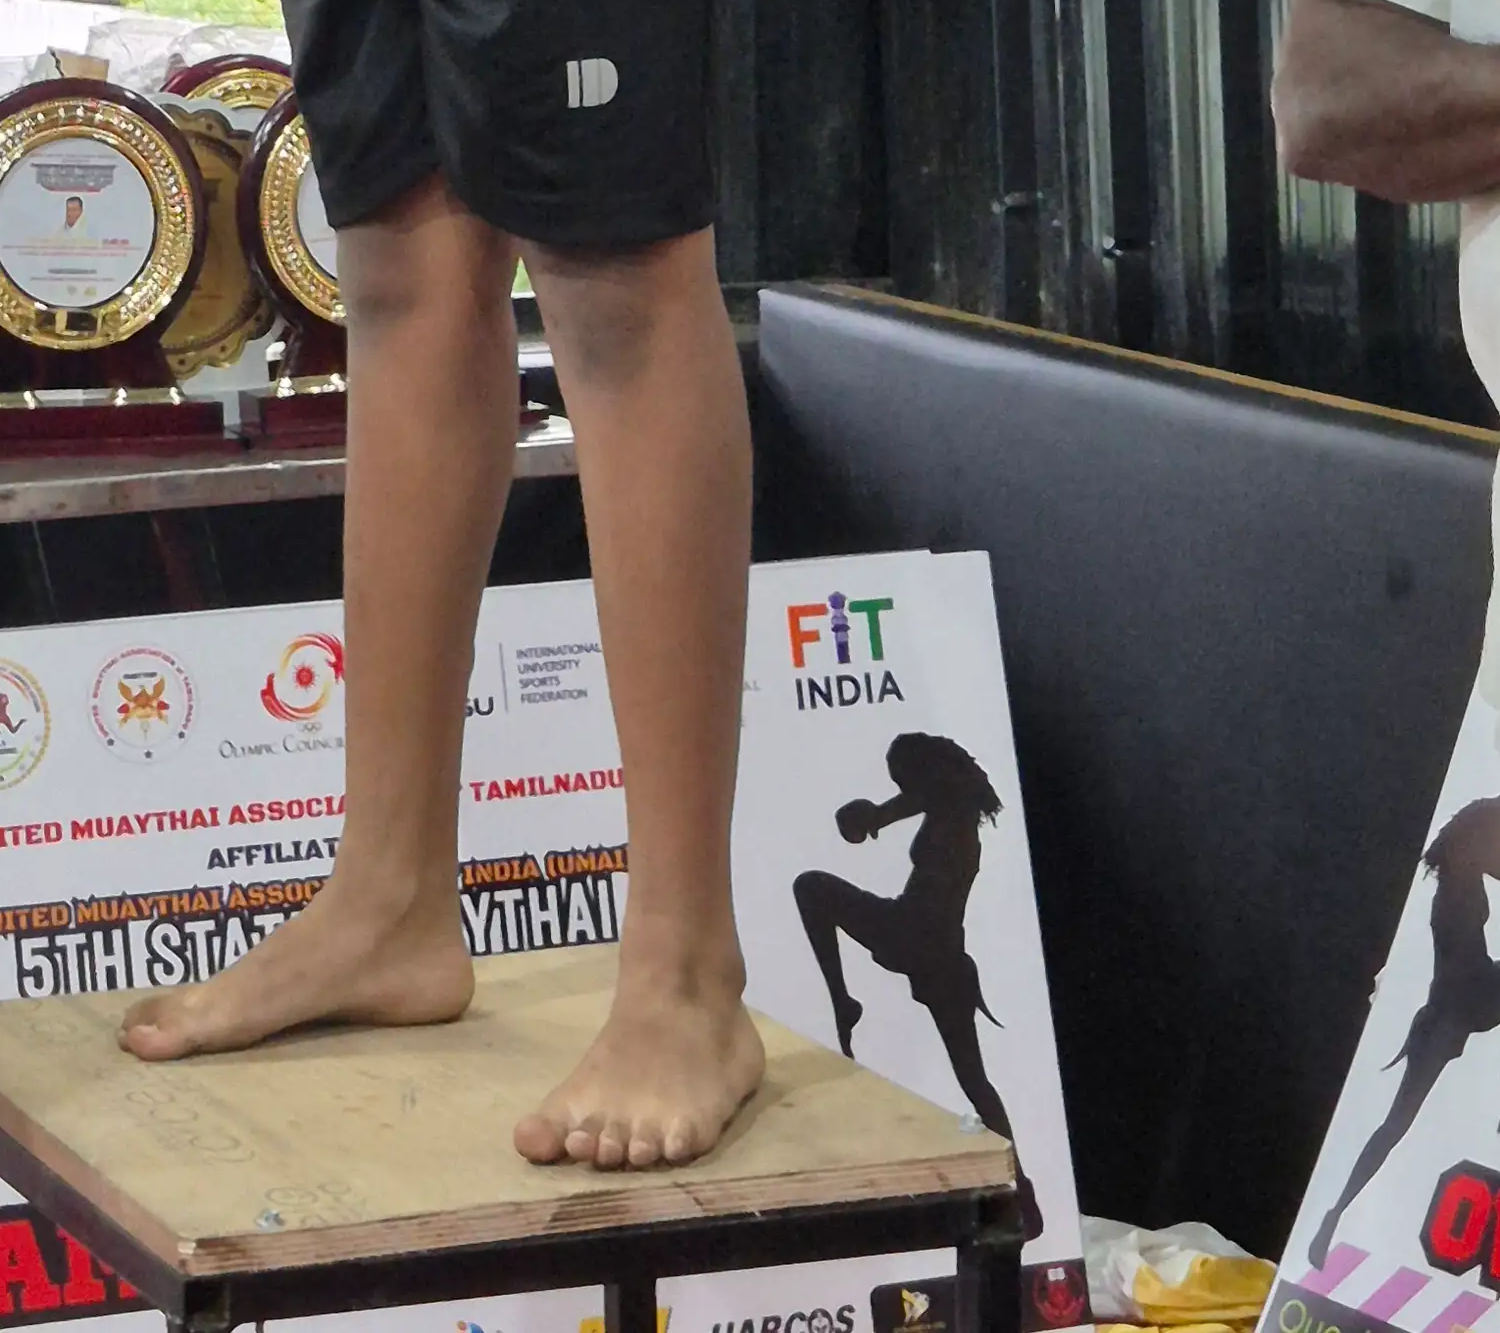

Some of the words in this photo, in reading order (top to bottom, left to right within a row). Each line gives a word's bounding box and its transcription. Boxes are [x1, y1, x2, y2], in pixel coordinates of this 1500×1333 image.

[517, 659, 581, 675] UNIVERSITY
[518, 676, 561, 689] SPORTS
[520, 689, 588, 704] FEDERATION
[795, 670, 905, 711] INDIA
[468, 769, 626, 803] TAMILNADU
[70, 806, 221, 841] MUAYTHAI
[463, 858, 540, 886] INDIA
[77, 889, 221, 924] MUAYTHAI
[20, 928, 127, 998] 5TH
